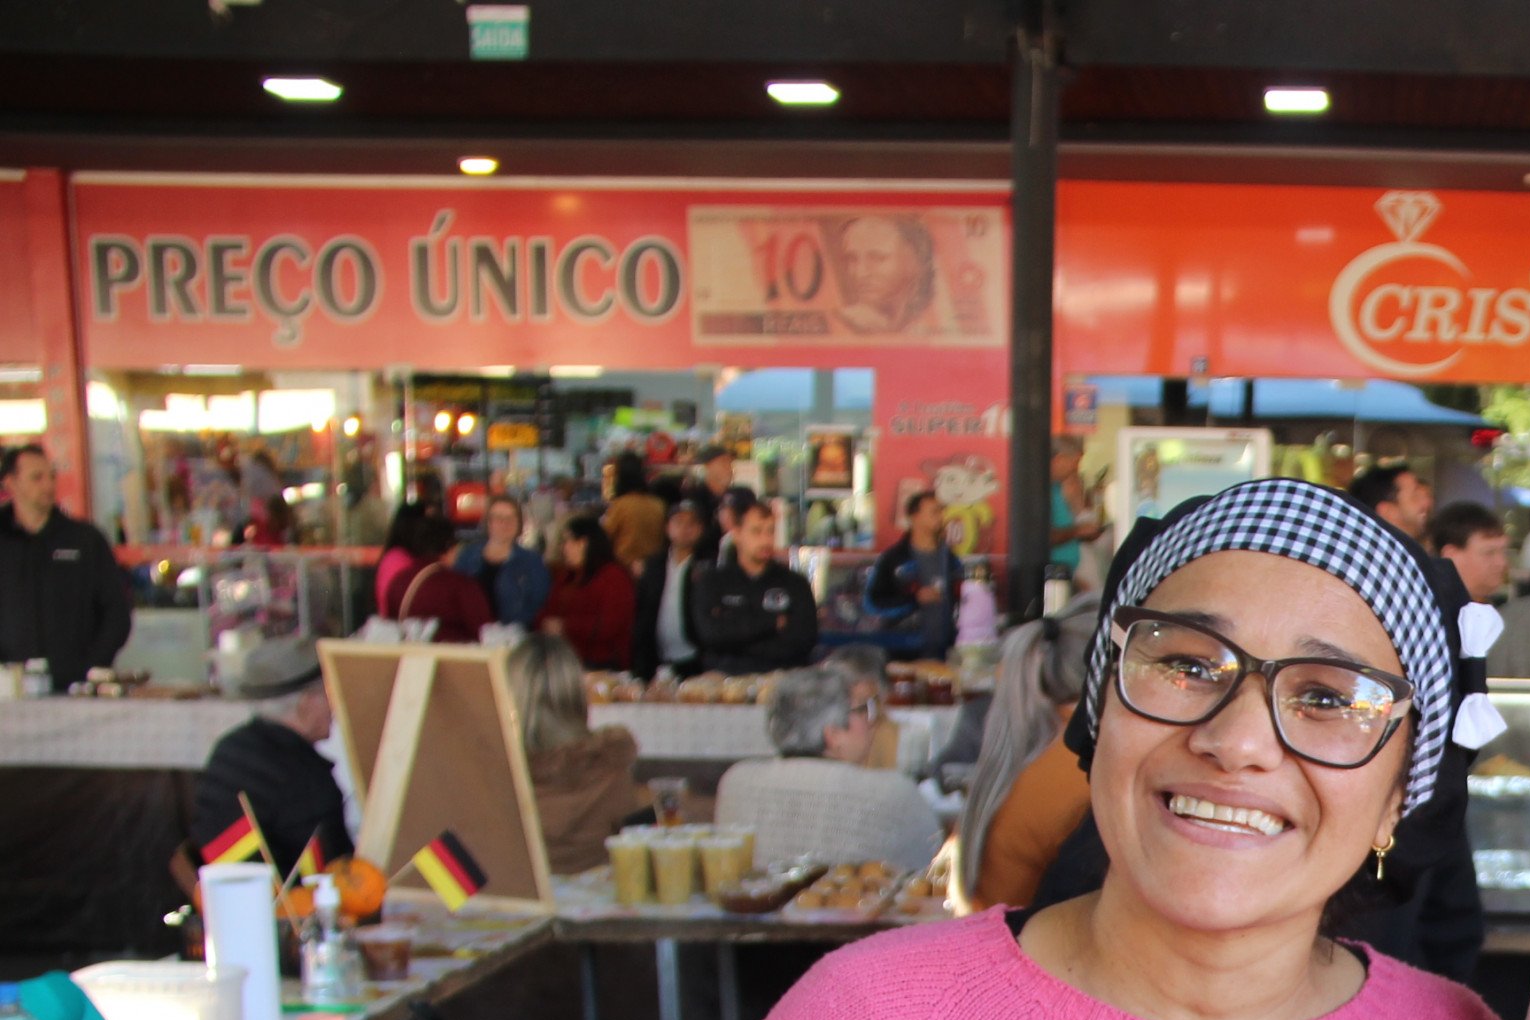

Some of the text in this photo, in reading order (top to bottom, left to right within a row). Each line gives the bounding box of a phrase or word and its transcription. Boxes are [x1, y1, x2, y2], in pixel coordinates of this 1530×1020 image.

[91, 208, 687, 347] PREÇO ÚNICO
[754, 232, 823, 302] 10
